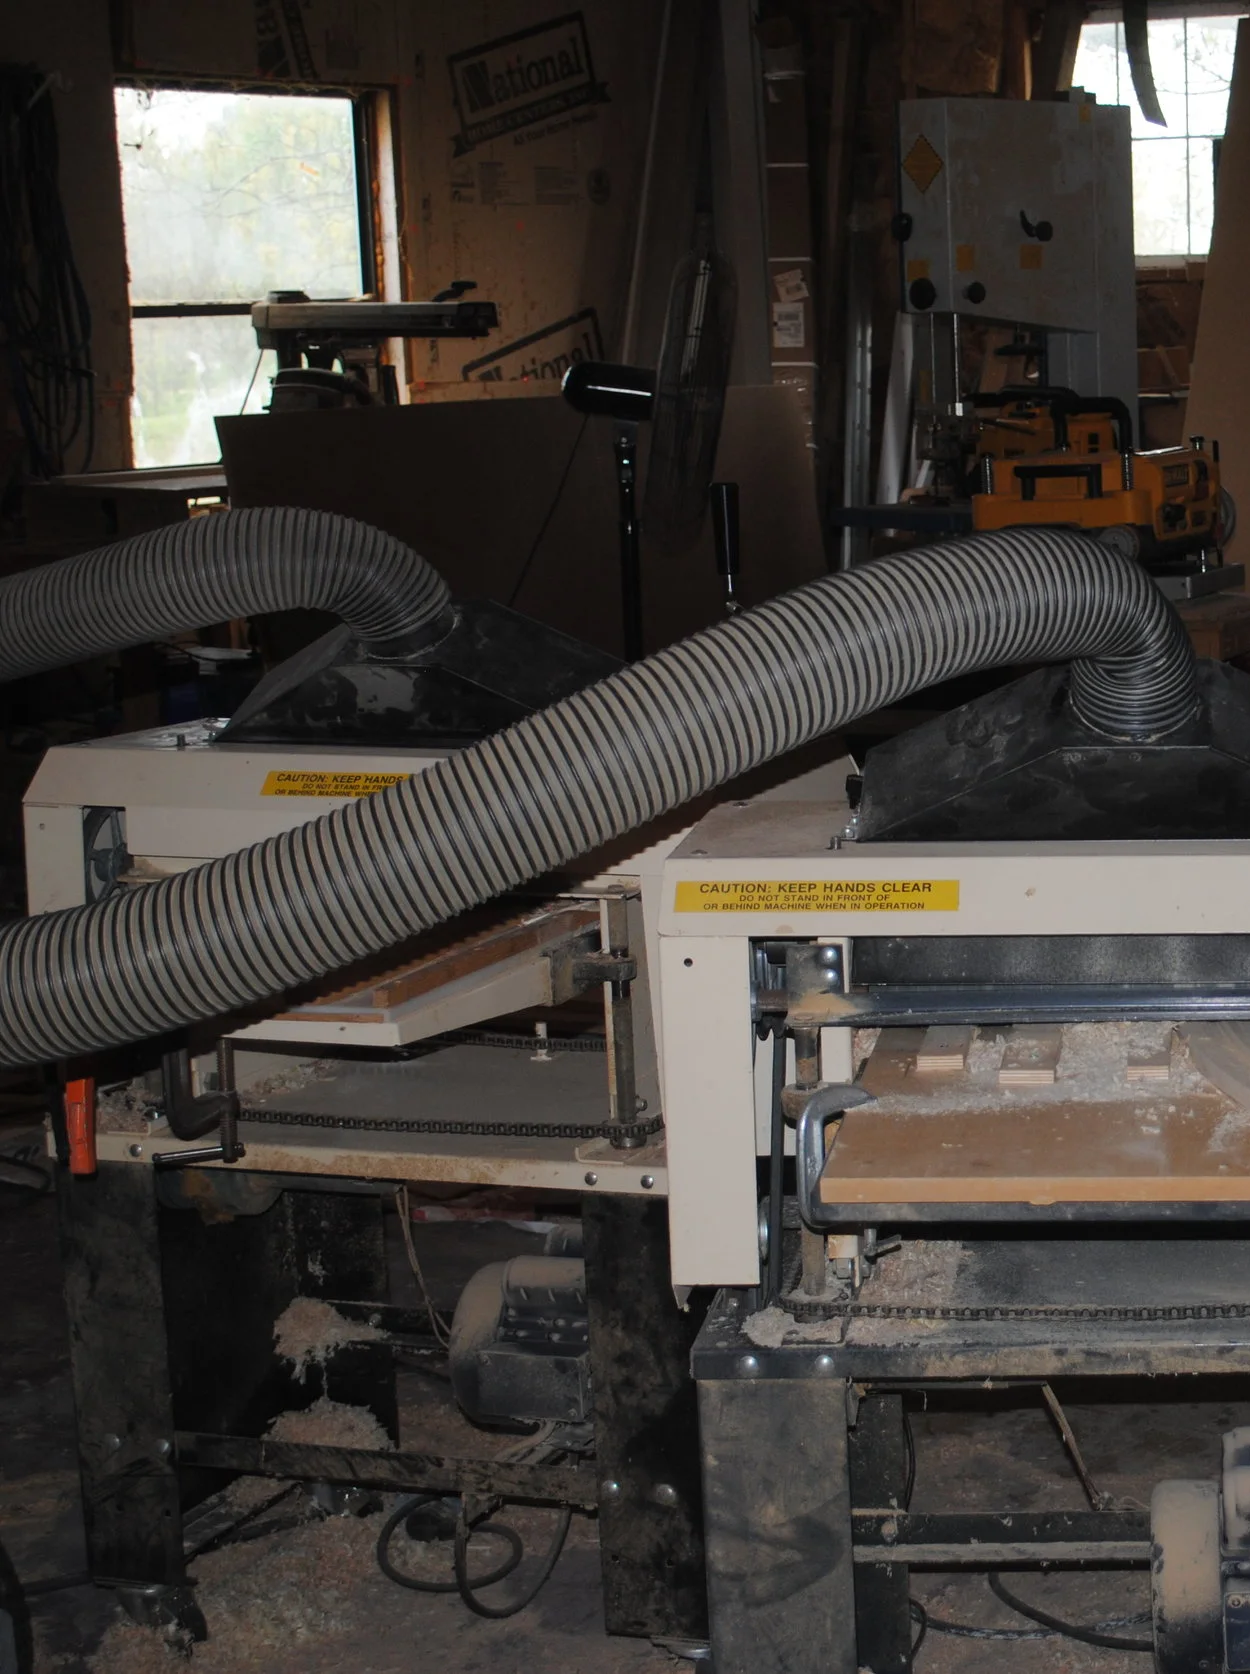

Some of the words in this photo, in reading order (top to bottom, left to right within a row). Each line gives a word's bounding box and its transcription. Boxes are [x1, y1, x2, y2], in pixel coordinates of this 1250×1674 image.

[462, 36, 585, 113] National
[277, 773, 328, 783] CAUTION:
[332, 775, 362, 783] KEEP
[364, 775, 403, 785] HANDS
[699, 883, 772, 894] CAUTION:
[777, 883, 817, 893] KEEP
[823, 883, 876, 893] HANDS
[881, 882, 932, 893] CLEAR
[739, 894, 753, 902] DO
[758, 894, 779, 902] NOT
[783, 894, 818, 902] STAND
[703, 902, 718, 910] OR
[722, 902, 761, 910] BEHIND
[764, 902, 810, 910] MACHINE
[815, 902, 847, 910] WHEN
